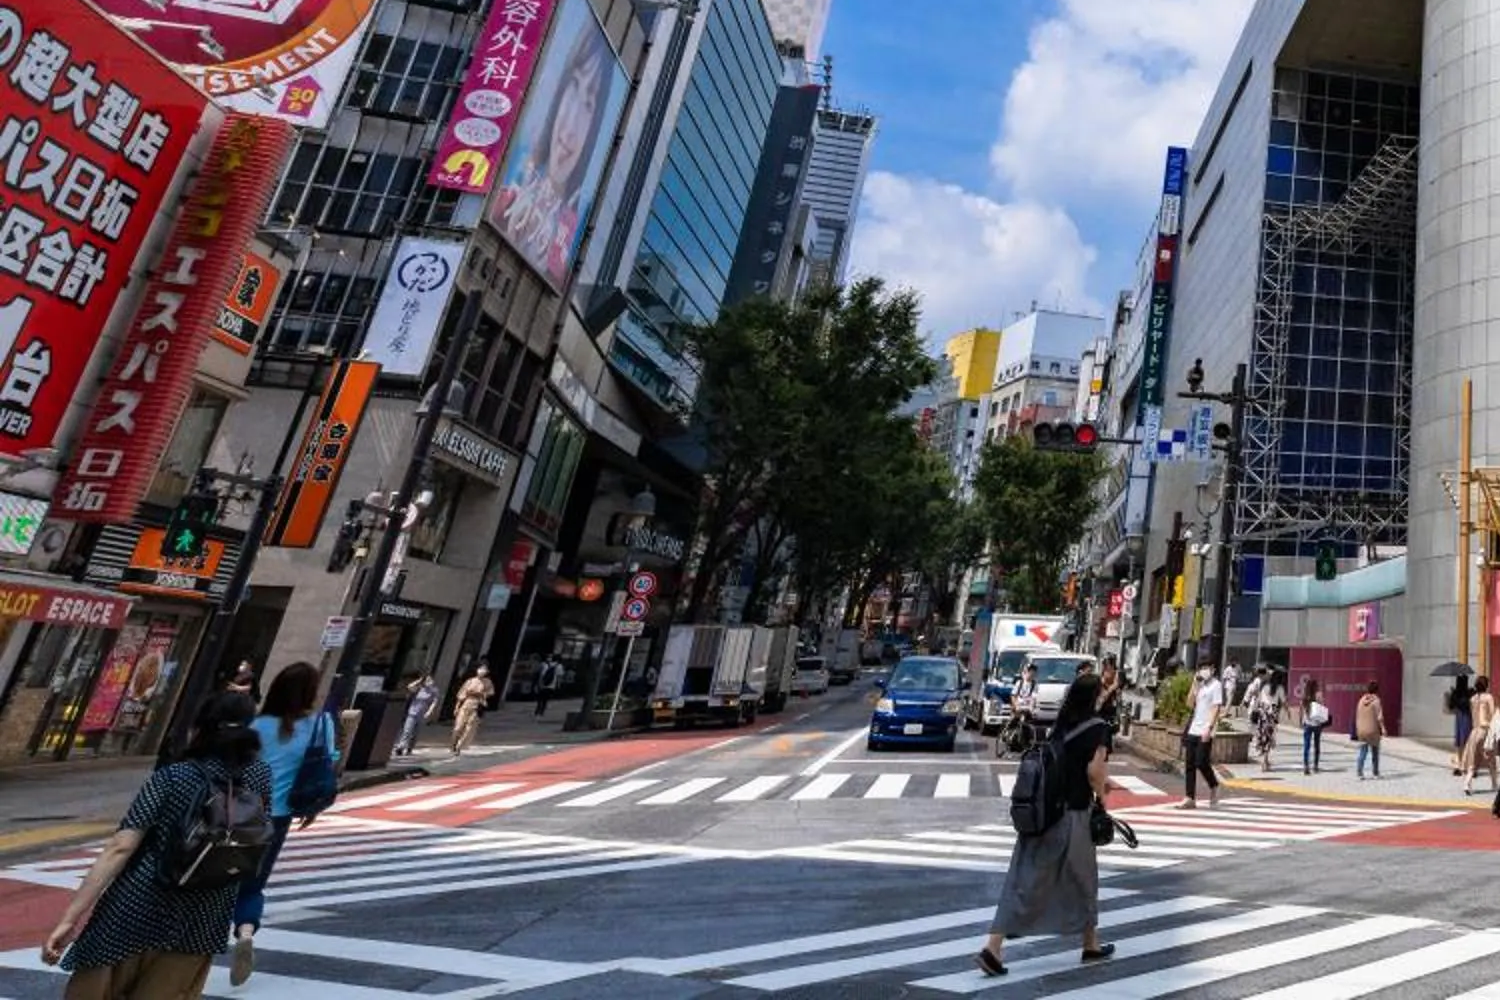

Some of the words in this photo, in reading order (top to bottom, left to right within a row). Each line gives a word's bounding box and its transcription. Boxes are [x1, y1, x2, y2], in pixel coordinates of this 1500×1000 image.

[287, 87, 316, 102] 30
[62, 246, 199, 512] エスパス日拓
[46, 596, 115, 624] ESPACE
